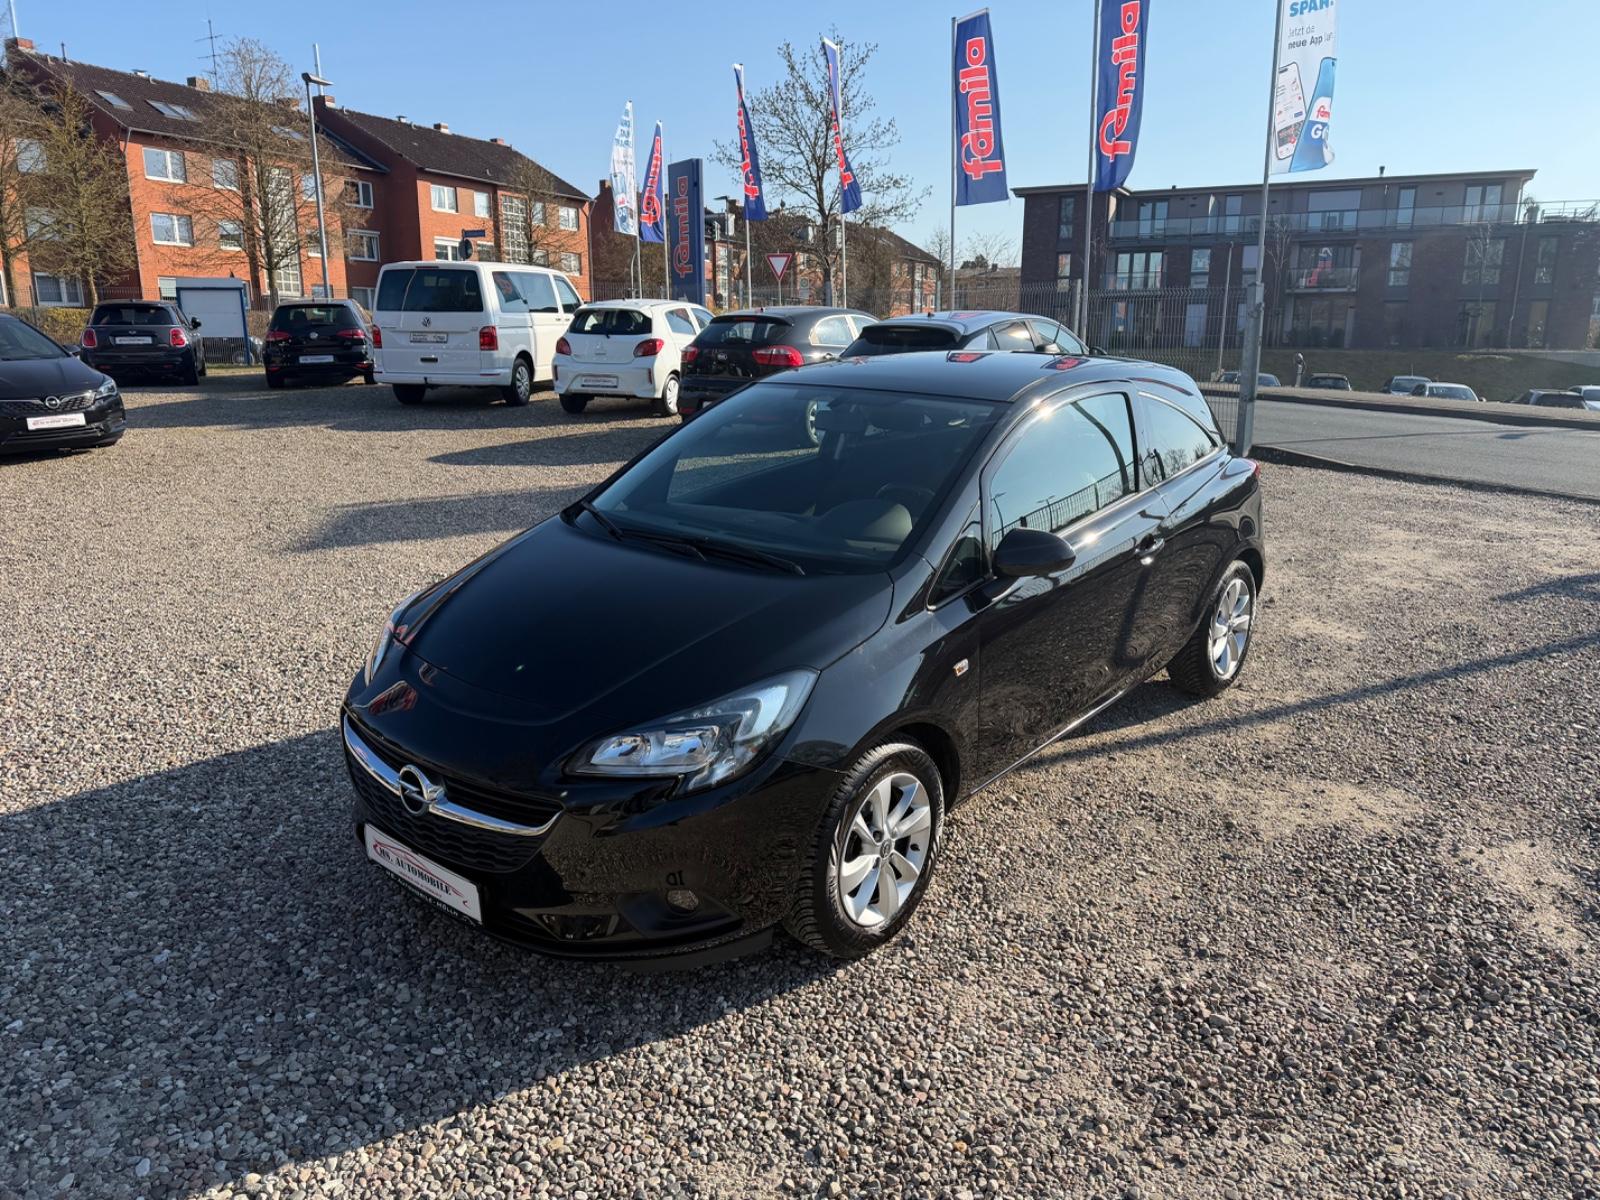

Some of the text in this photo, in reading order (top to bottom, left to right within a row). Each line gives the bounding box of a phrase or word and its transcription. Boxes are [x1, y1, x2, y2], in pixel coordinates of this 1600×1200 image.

[1099, 0, 1140, 163] famila
[1310, 35, 1323, 46] App
[959, 36, 1003, 180] famila
[673, 175, 694, 279] famila
